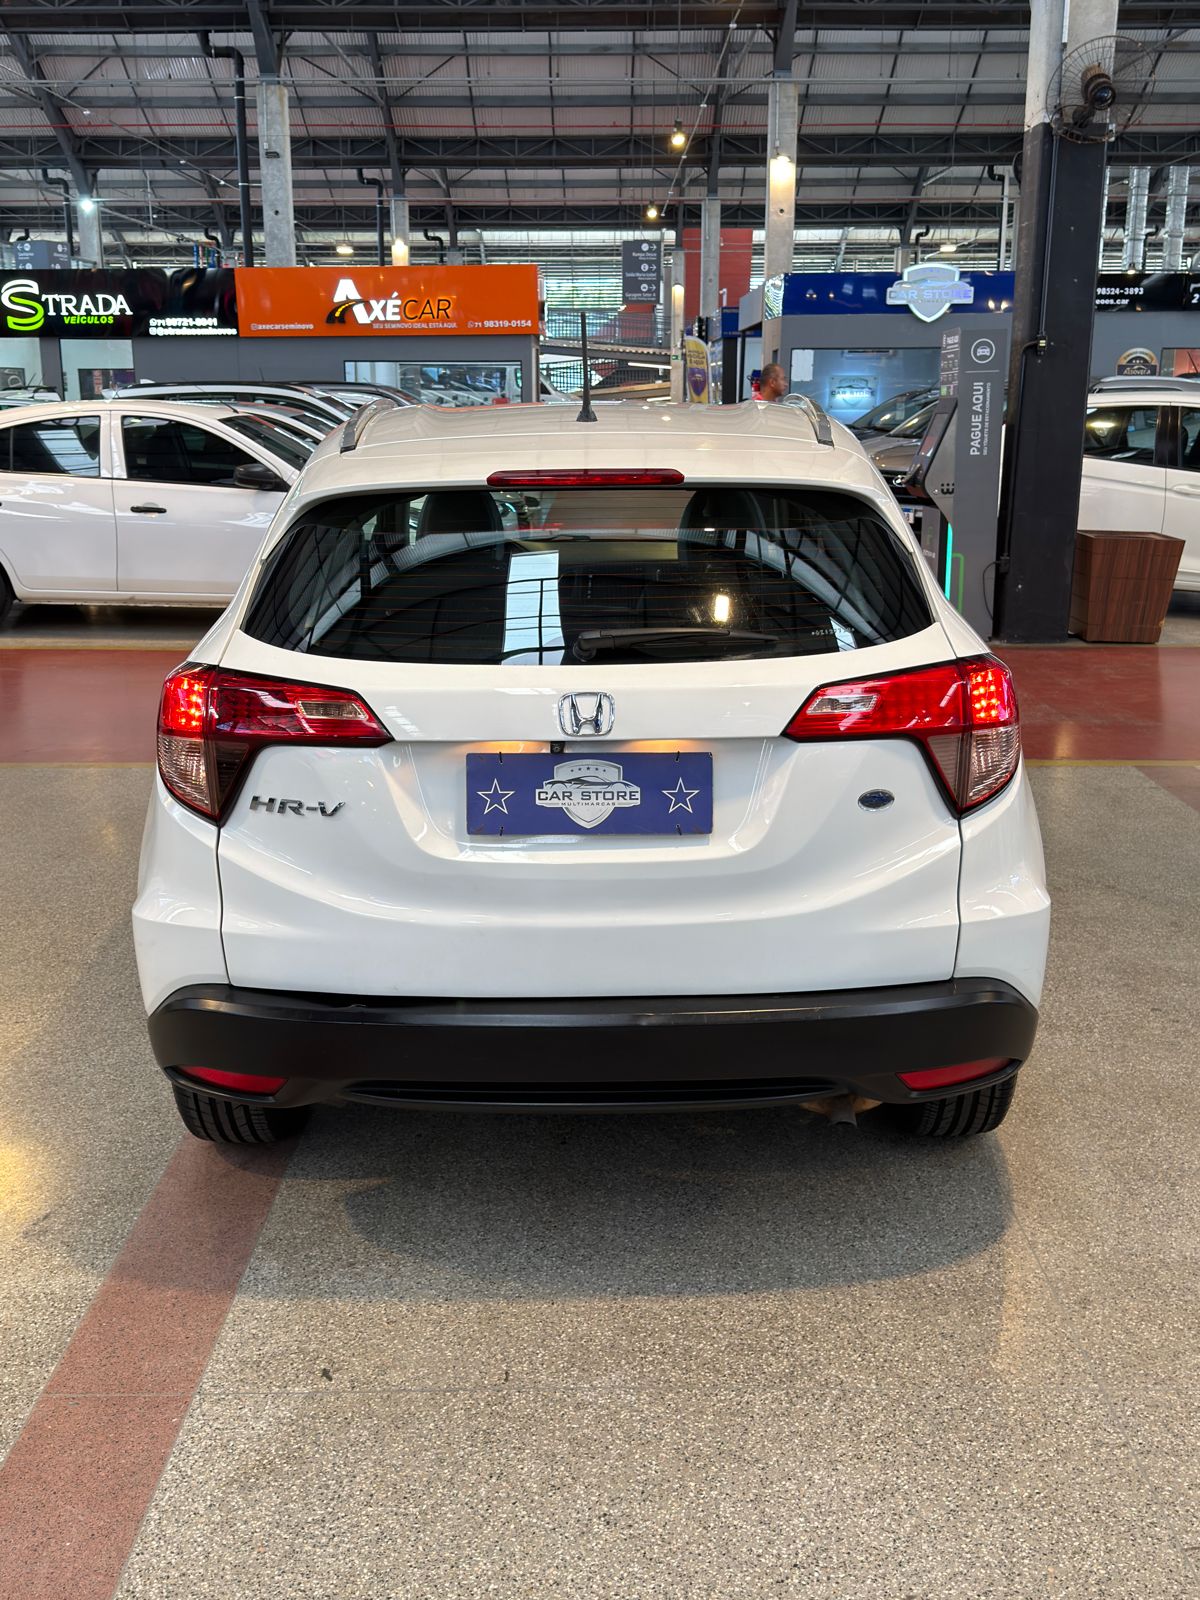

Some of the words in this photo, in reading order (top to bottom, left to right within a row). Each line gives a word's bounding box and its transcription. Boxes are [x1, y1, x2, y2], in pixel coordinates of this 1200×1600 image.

[888, 289, 918, 299] CAR
[923, 288, 973, 299] STORE
[1096, 287, 1144, 295] 98524-3893
[1, 279, 133, 331] STRADA
[402, 299, 452, 320] CAR
[64, 314, 114, 324] VEÍCULOS
[483, 320, 532, 328] 98319-0154
[972, 381, 984, 413] AQUI
[969, 414, 982, 456] PAGUE
[537, 790, 573, 801] CAR
[581, 790, 639, 801] STORE
[249, 795, 346, 817] HR-V
